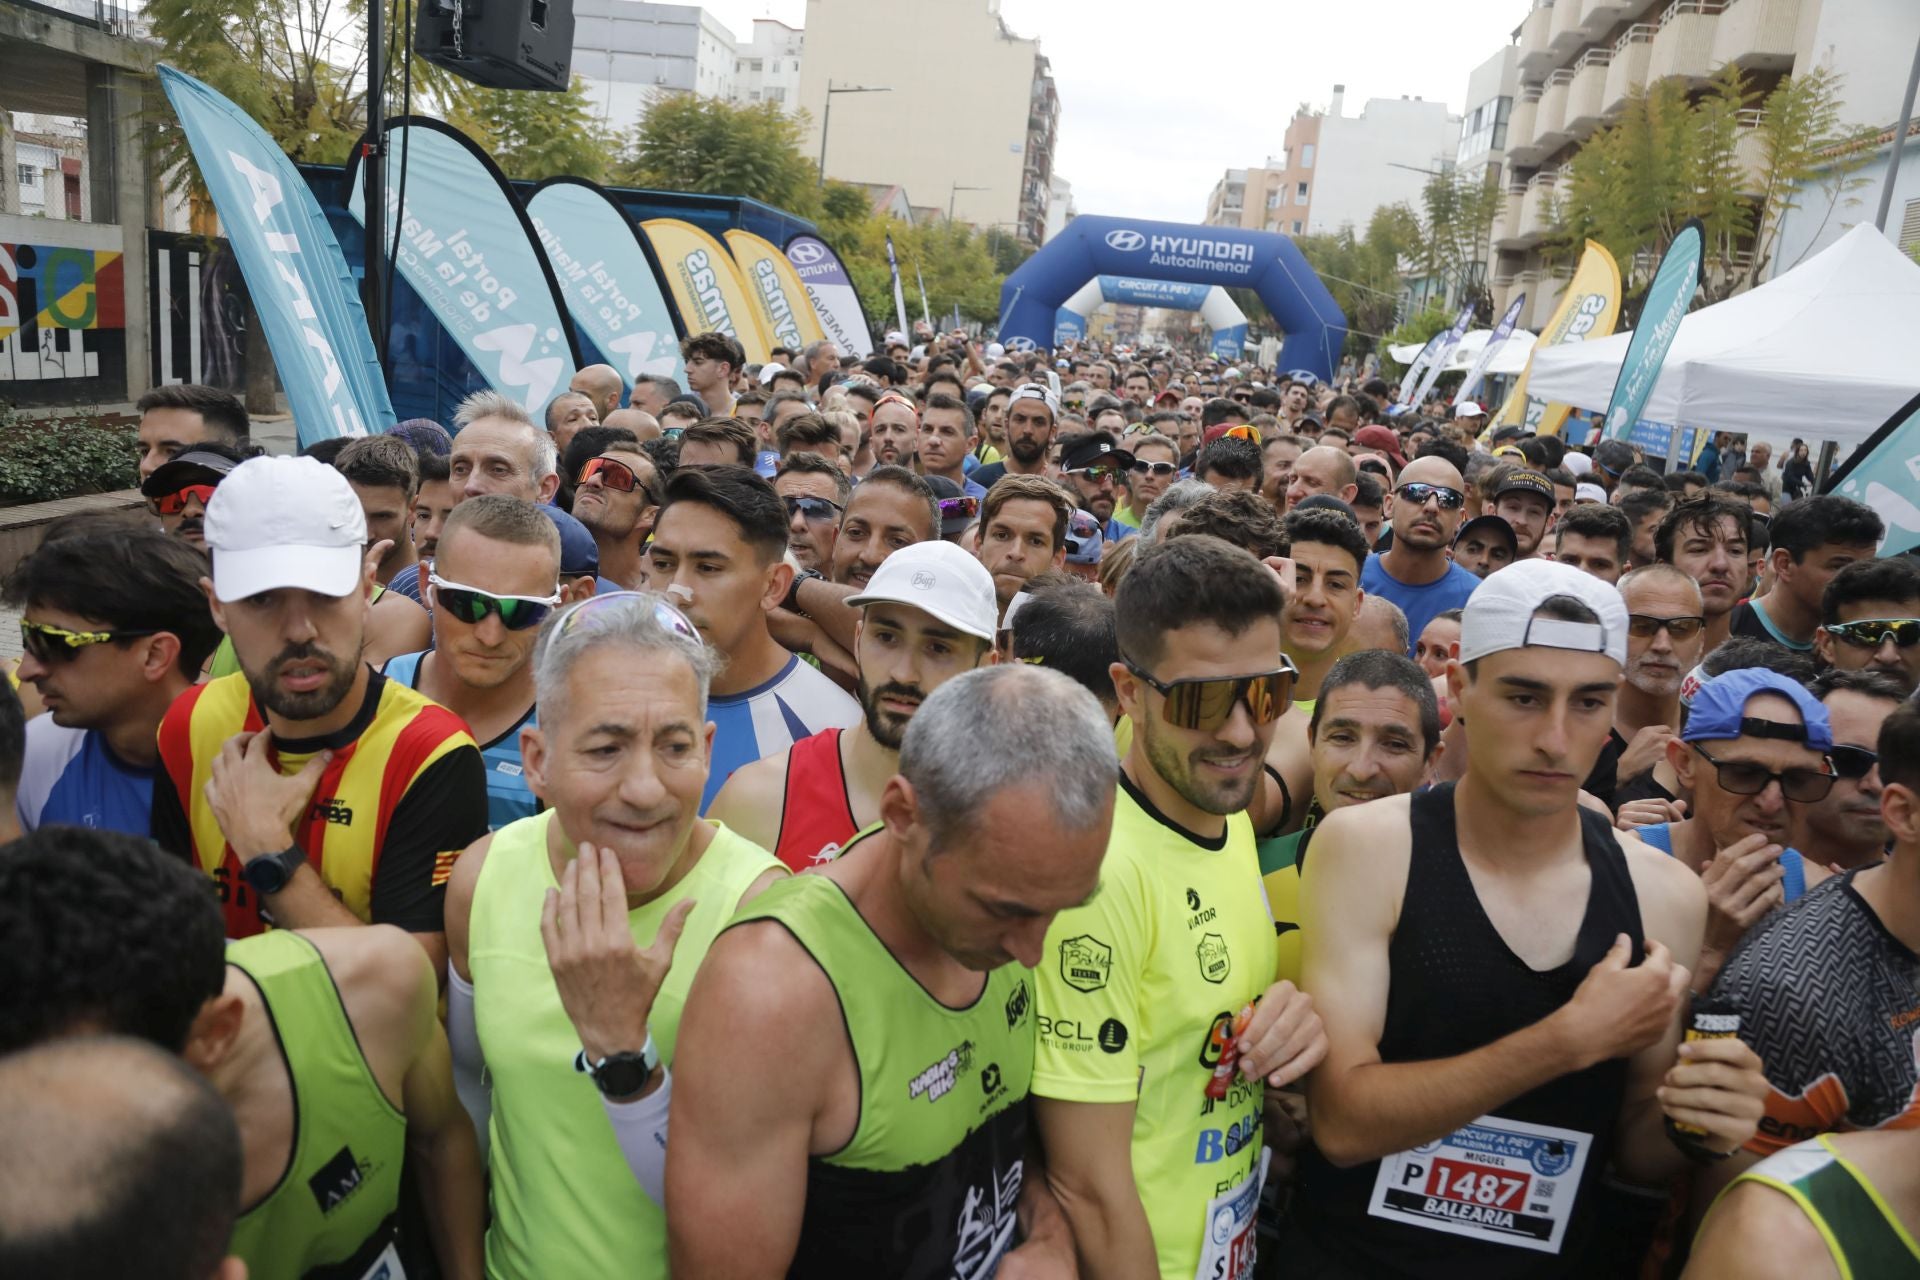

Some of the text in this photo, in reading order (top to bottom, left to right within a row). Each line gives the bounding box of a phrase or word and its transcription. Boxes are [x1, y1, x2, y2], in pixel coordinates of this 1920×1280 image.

[1150, 235, 1254, 261] HYUNDAI
[1150, 252, 1251, 274] Autoalmenar
[1118, 280, 1191, 295] CIRCUIT A PEU
[1037, 1015, 1093, 1040] BCL
[1452, 1137, 1524, 1157] MARINA ALTA
[1495, 1135, 1506, 1145] A
[1508, 1138, 1533, 1149] PEU
[1464, 1151, 1506, 1167] MIGUEL
[1401, 1163, 1525, 1208] P 1487
[1423, 1198, 1514, 1228] BALEARIA
